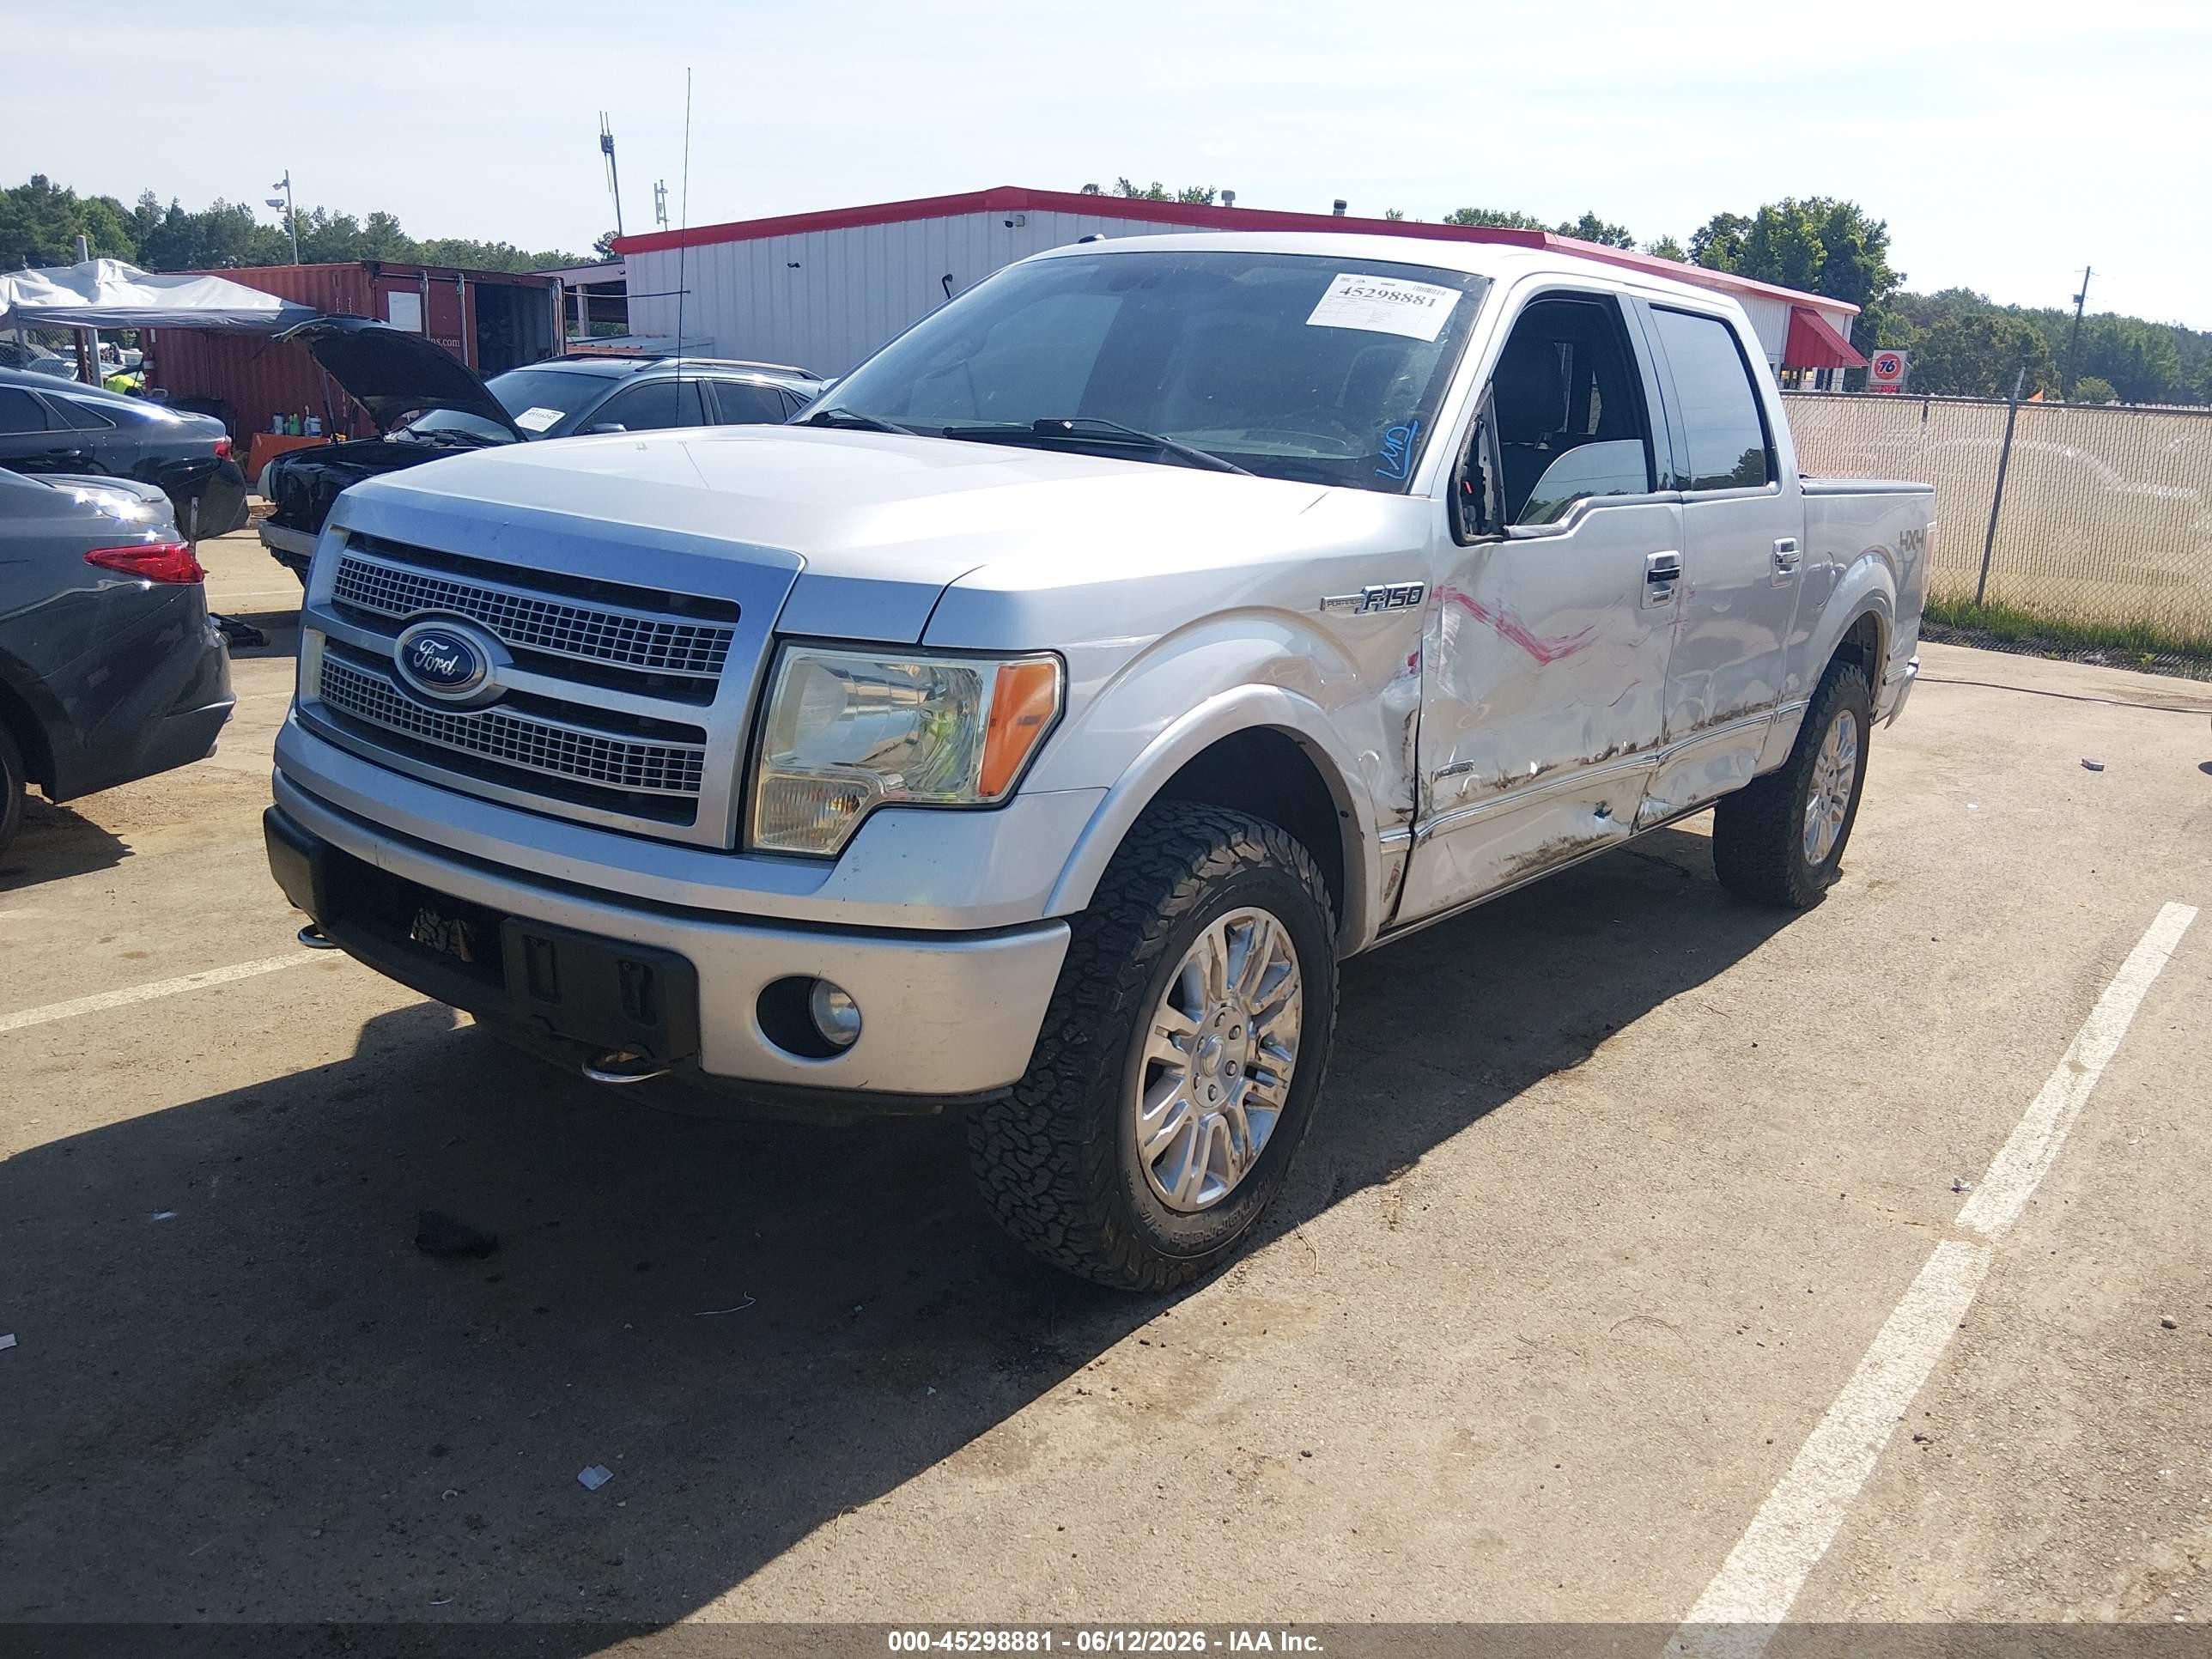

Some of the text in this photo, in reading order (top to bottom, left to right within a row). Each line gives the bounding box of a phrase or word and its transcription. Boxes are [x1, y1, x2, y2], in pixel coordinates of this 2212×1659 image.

[1340, 286, 1437, 307] 45298881
[1877, 358, 1898, 374] 76
[414, 639, 459, 676] Ford
